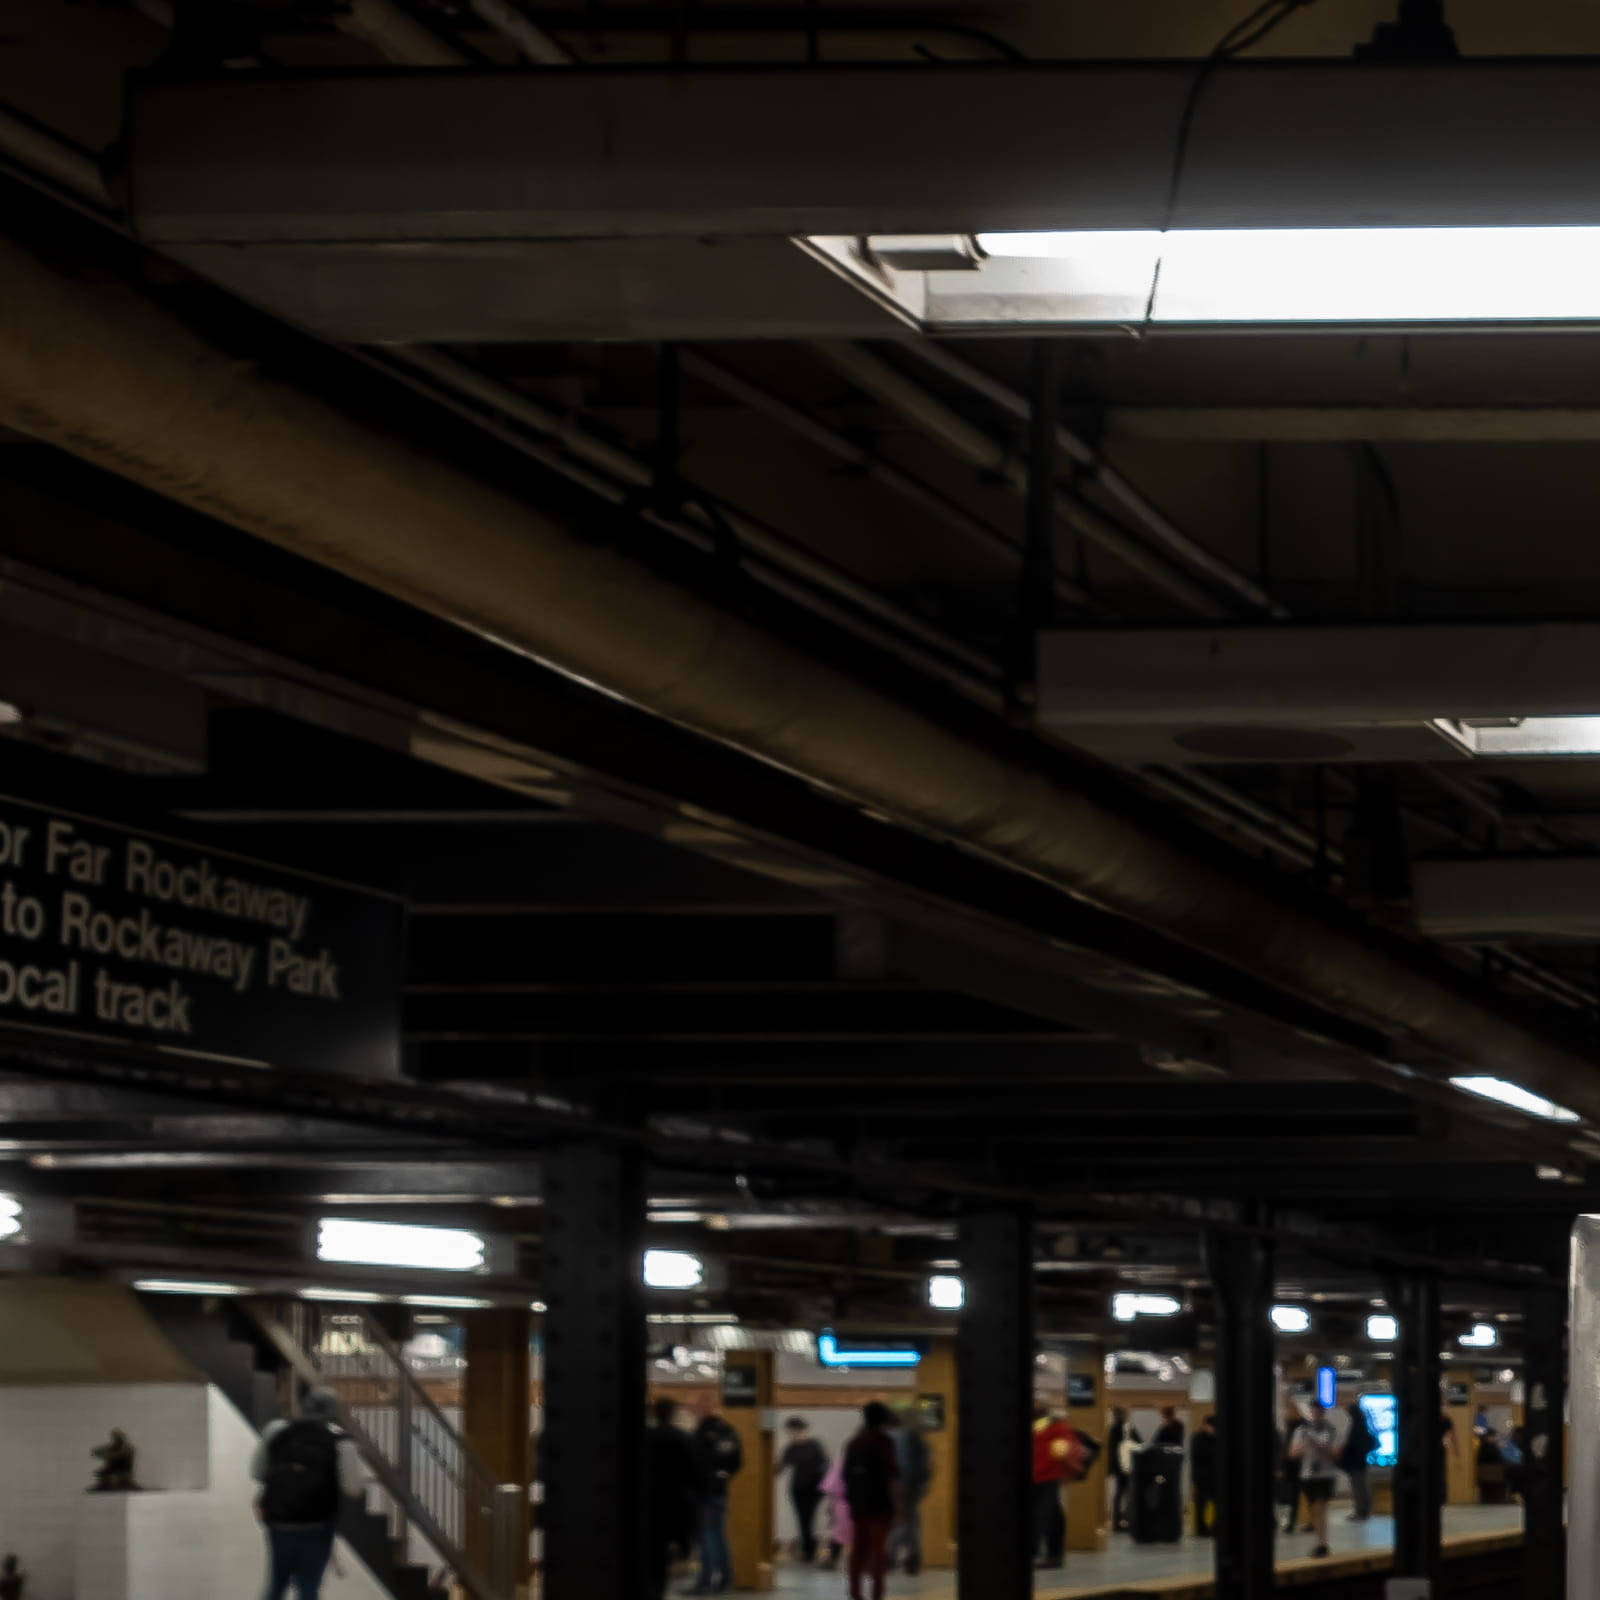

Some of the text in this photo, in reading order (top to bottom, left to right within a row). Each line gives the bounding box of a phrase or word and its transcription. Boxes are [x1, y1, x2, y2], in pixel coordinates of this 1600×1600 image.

[42, 818, 111, 885] Far
[124, 837, 311, 942] Rockaway
[59, 889, 256, 995] Rockaway
[266, 936, 341, 1001] Park
[95, 967, 193, 1035] track
